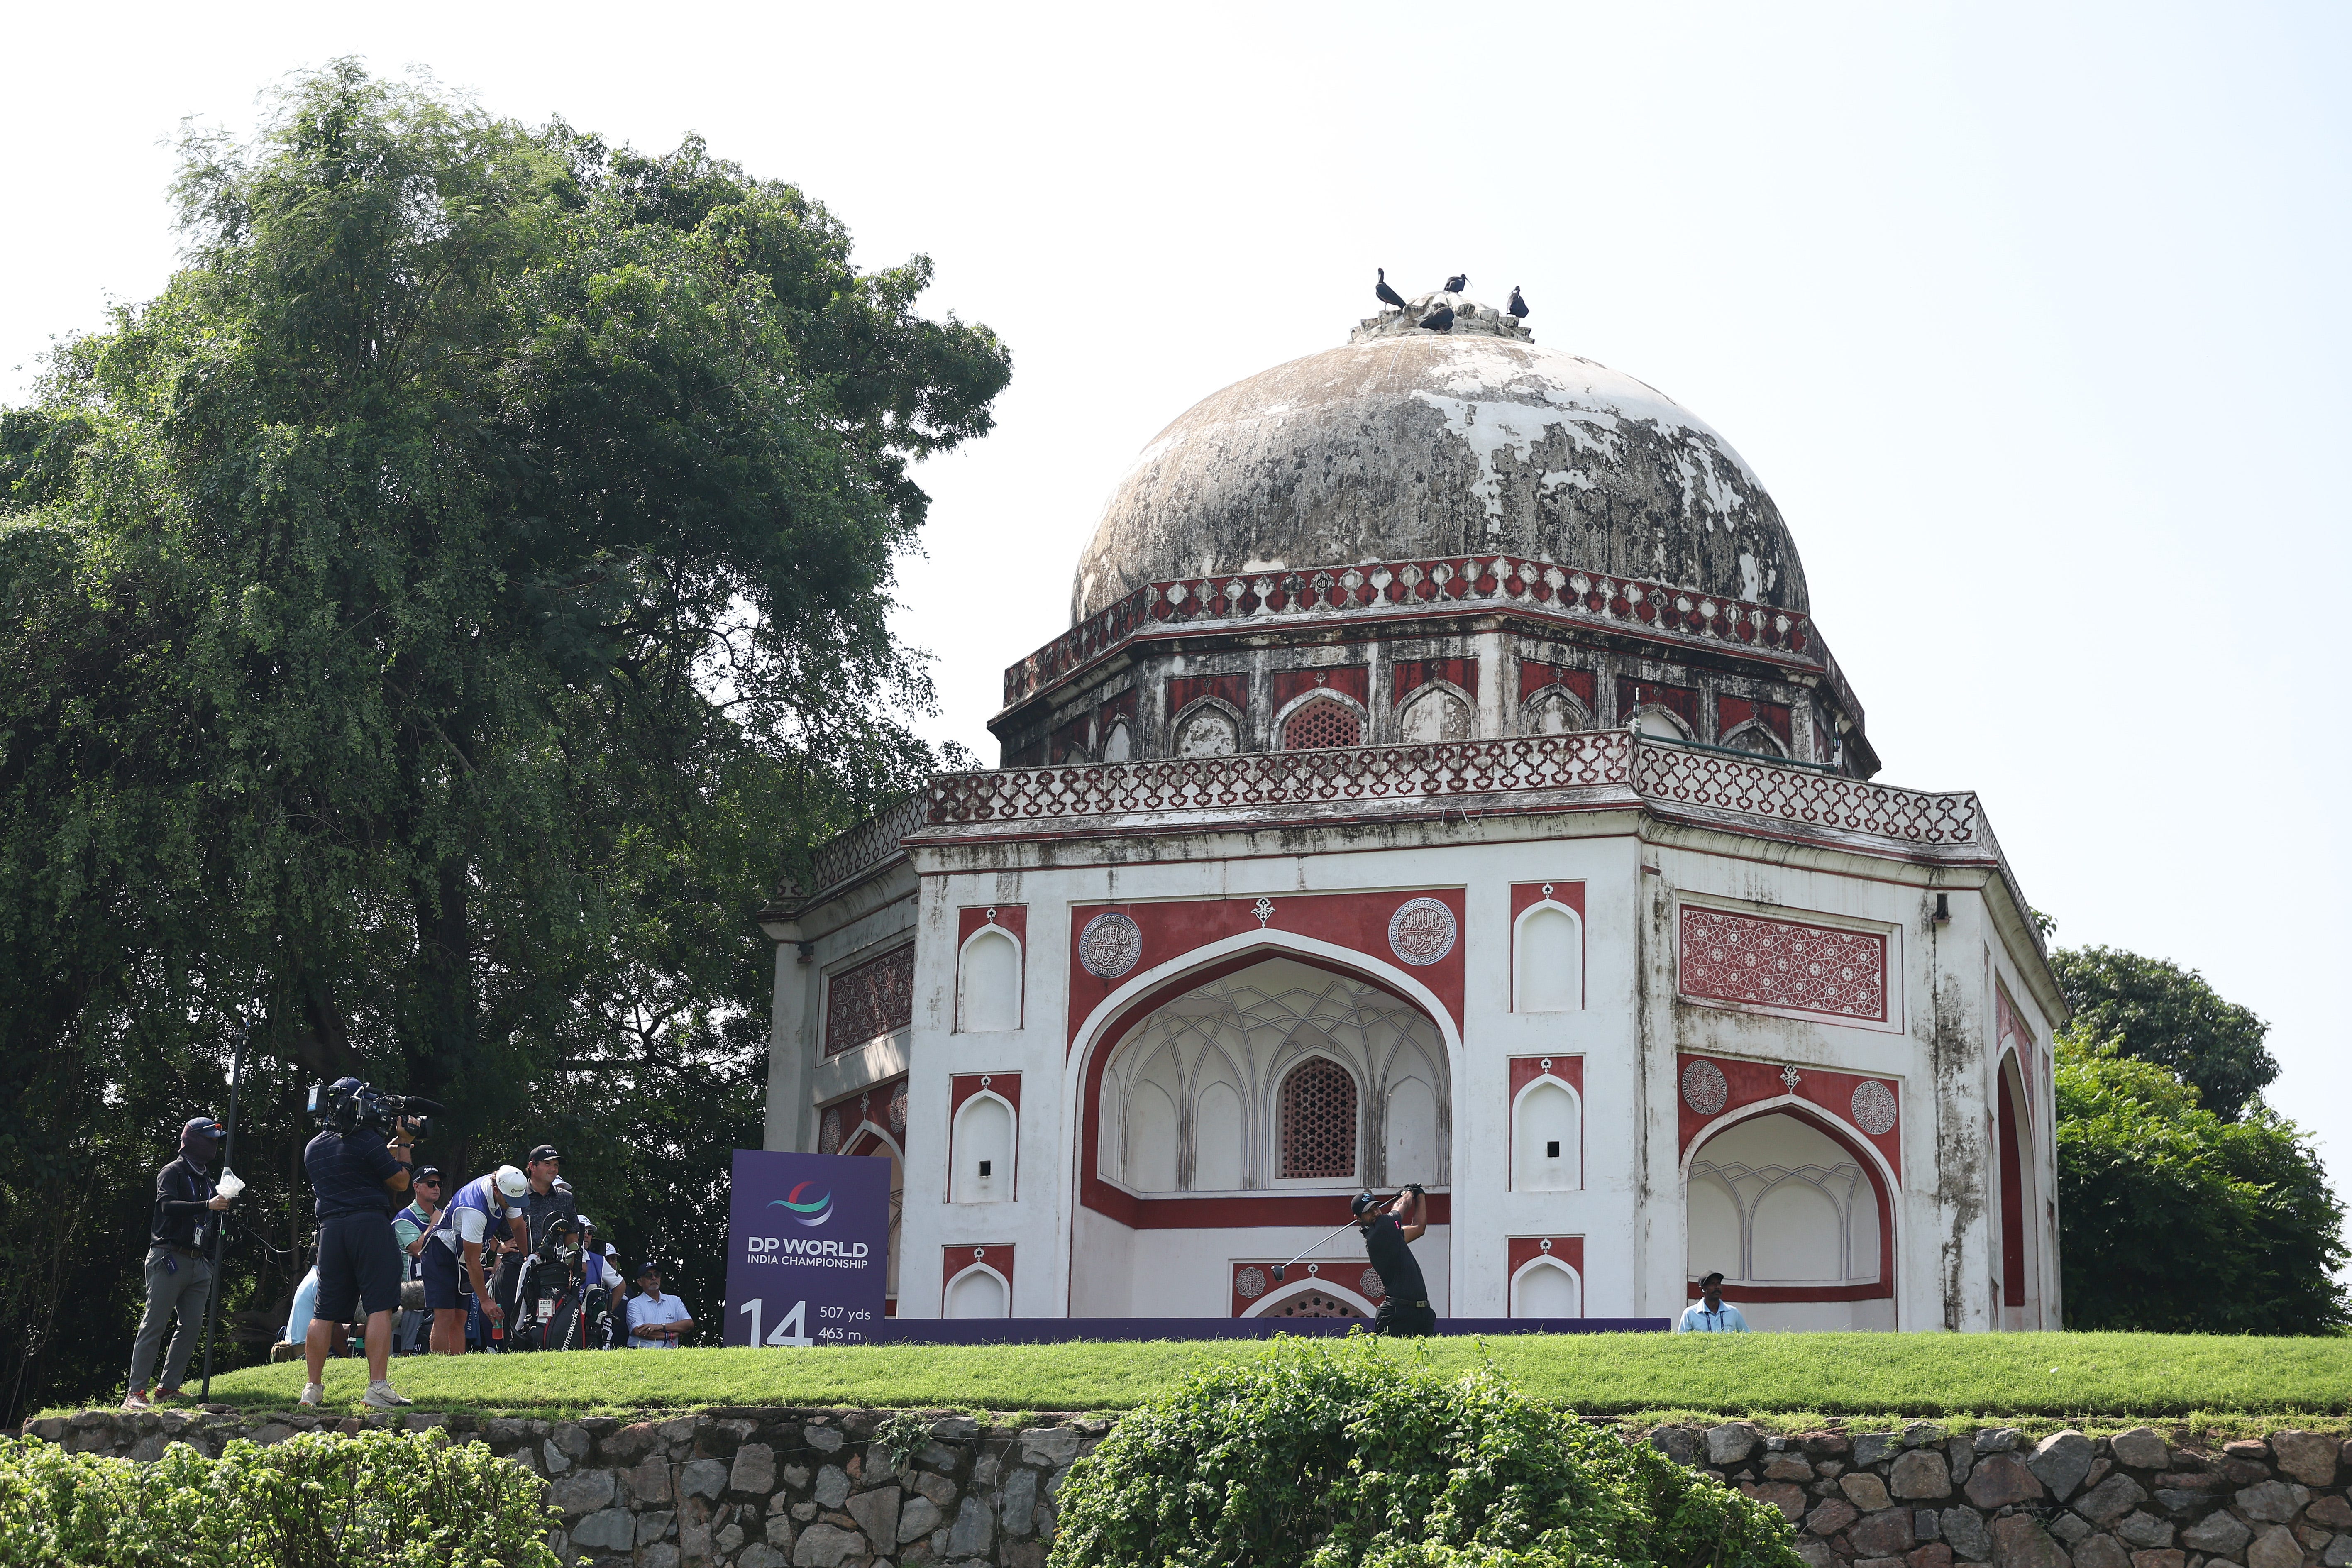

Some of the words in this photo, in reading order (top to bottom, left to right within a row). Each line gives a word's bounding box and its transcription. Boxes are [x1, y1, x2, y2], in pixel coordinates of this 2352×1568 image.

[748, 1236, 779, 1253] DP
[783, 1238, 869, 1258] WORLD
[747, 1254, 779, 1264] INDIA
[781, 1256, 868, 1269] CHAMPIONSHIP
[740, 1298, 813, 1348] 14
[820, 1306, 844, 1319] 507
[848, 1308, 871, 1323] yds
[562, 1308, 579, 1351] grindworks
[818, 1327, 843, 1339] 463
[848, 1331, 861, 1340] m
